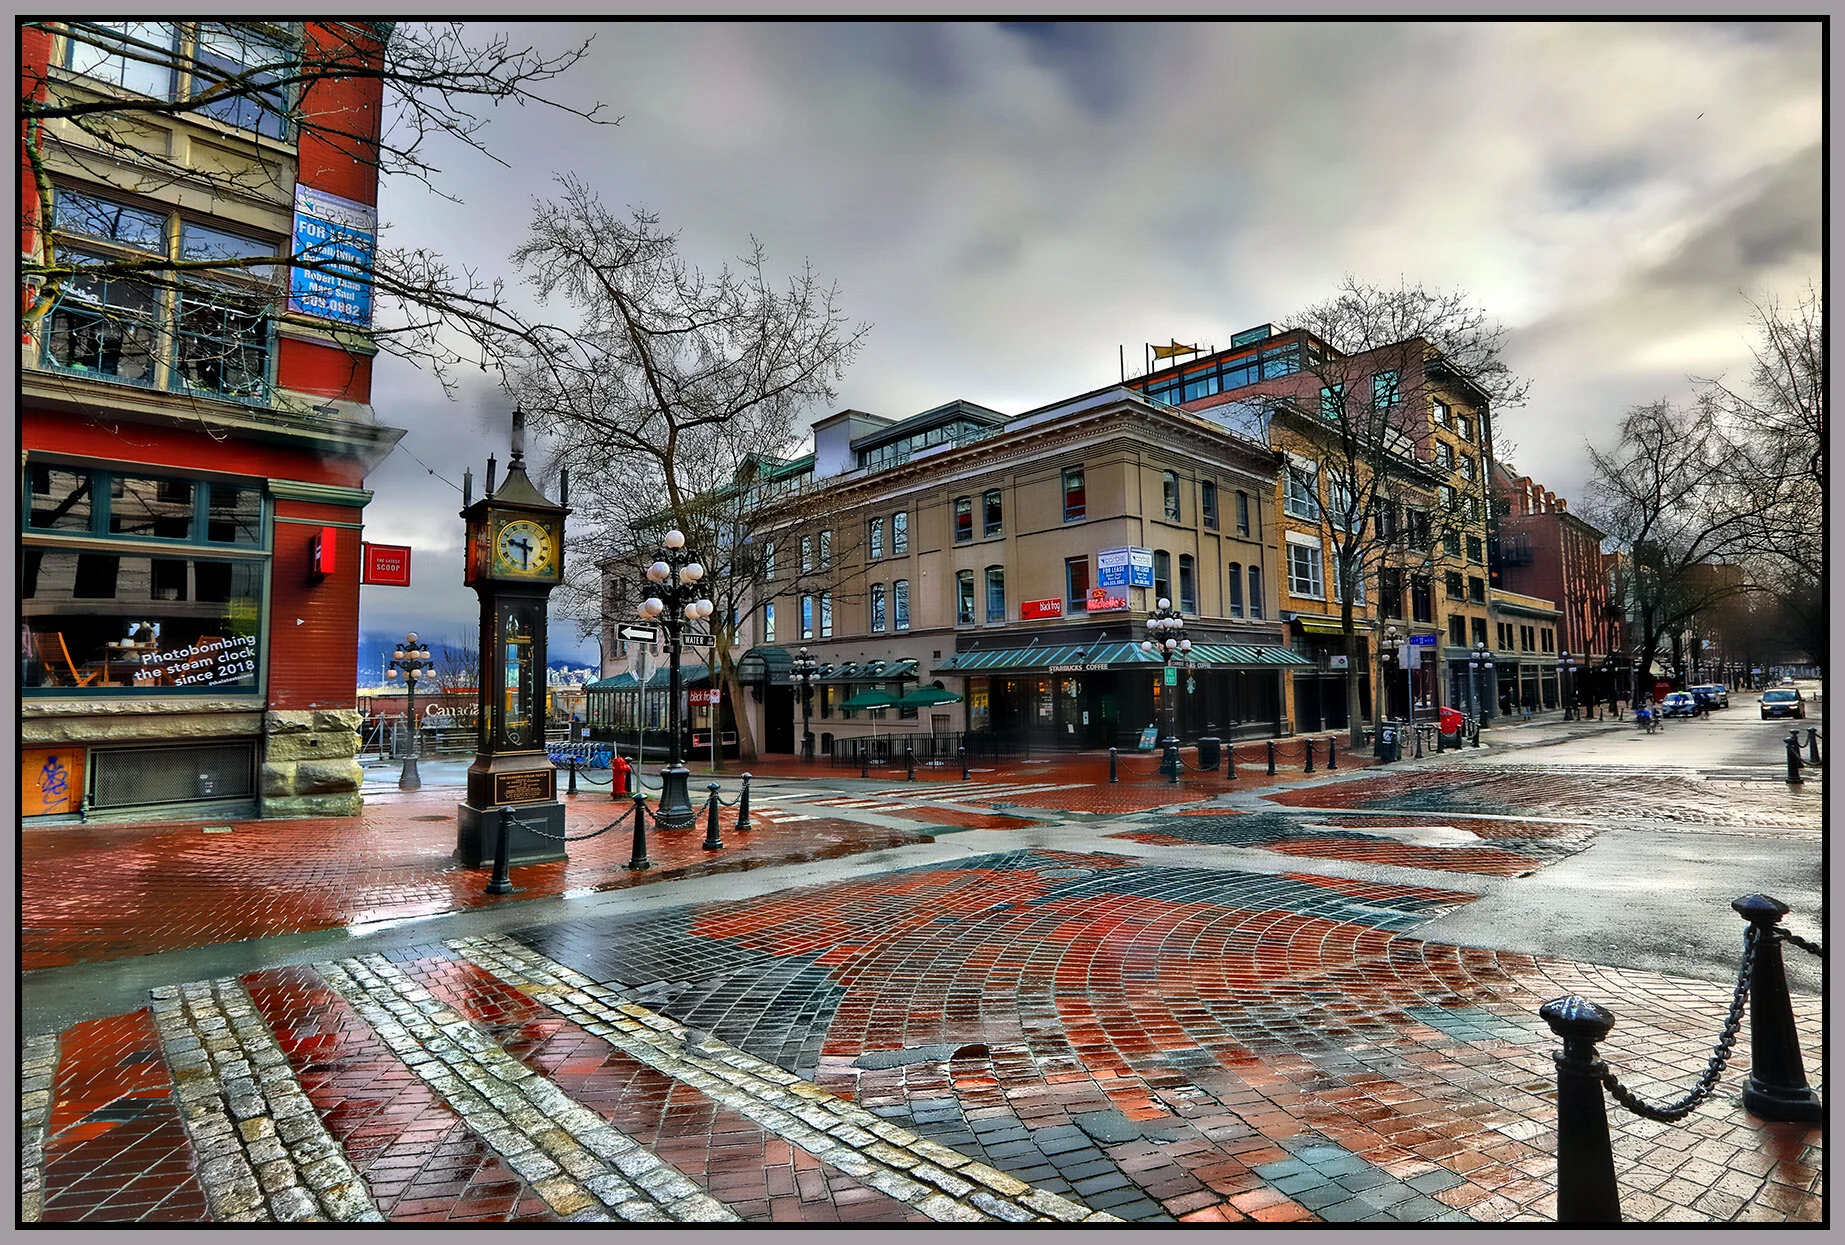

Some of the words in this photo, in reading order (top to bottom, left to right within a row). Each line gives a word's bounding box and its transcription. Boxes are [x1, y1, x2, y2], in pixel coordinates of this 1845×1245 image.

[299, 220, 326, 240] FOR
[303, 269, 335, 285] Robert
[308, 281, 333, 295] Marc
[335, 288, 355, 301] Saul
[376, 563, 401, 572] SCOOP
[1040, 601, 1051, 612] black
[1051, 600, 1060, 613] frog
[1087, 596, 1126, 610] Michelle's
[685, 636, 704, 645] WATER
[141, 635, 256, 665] Photobombing
[133, 668, 162, 682] the
[166, 657, 214, 676] steam
[217, 647, 256, 663] clock
[174, 671, 213, 687] since
[217, 660, 256, 677] 2018
[690, 691, 702, 702] black
[703, 691, 711, 702] fro
